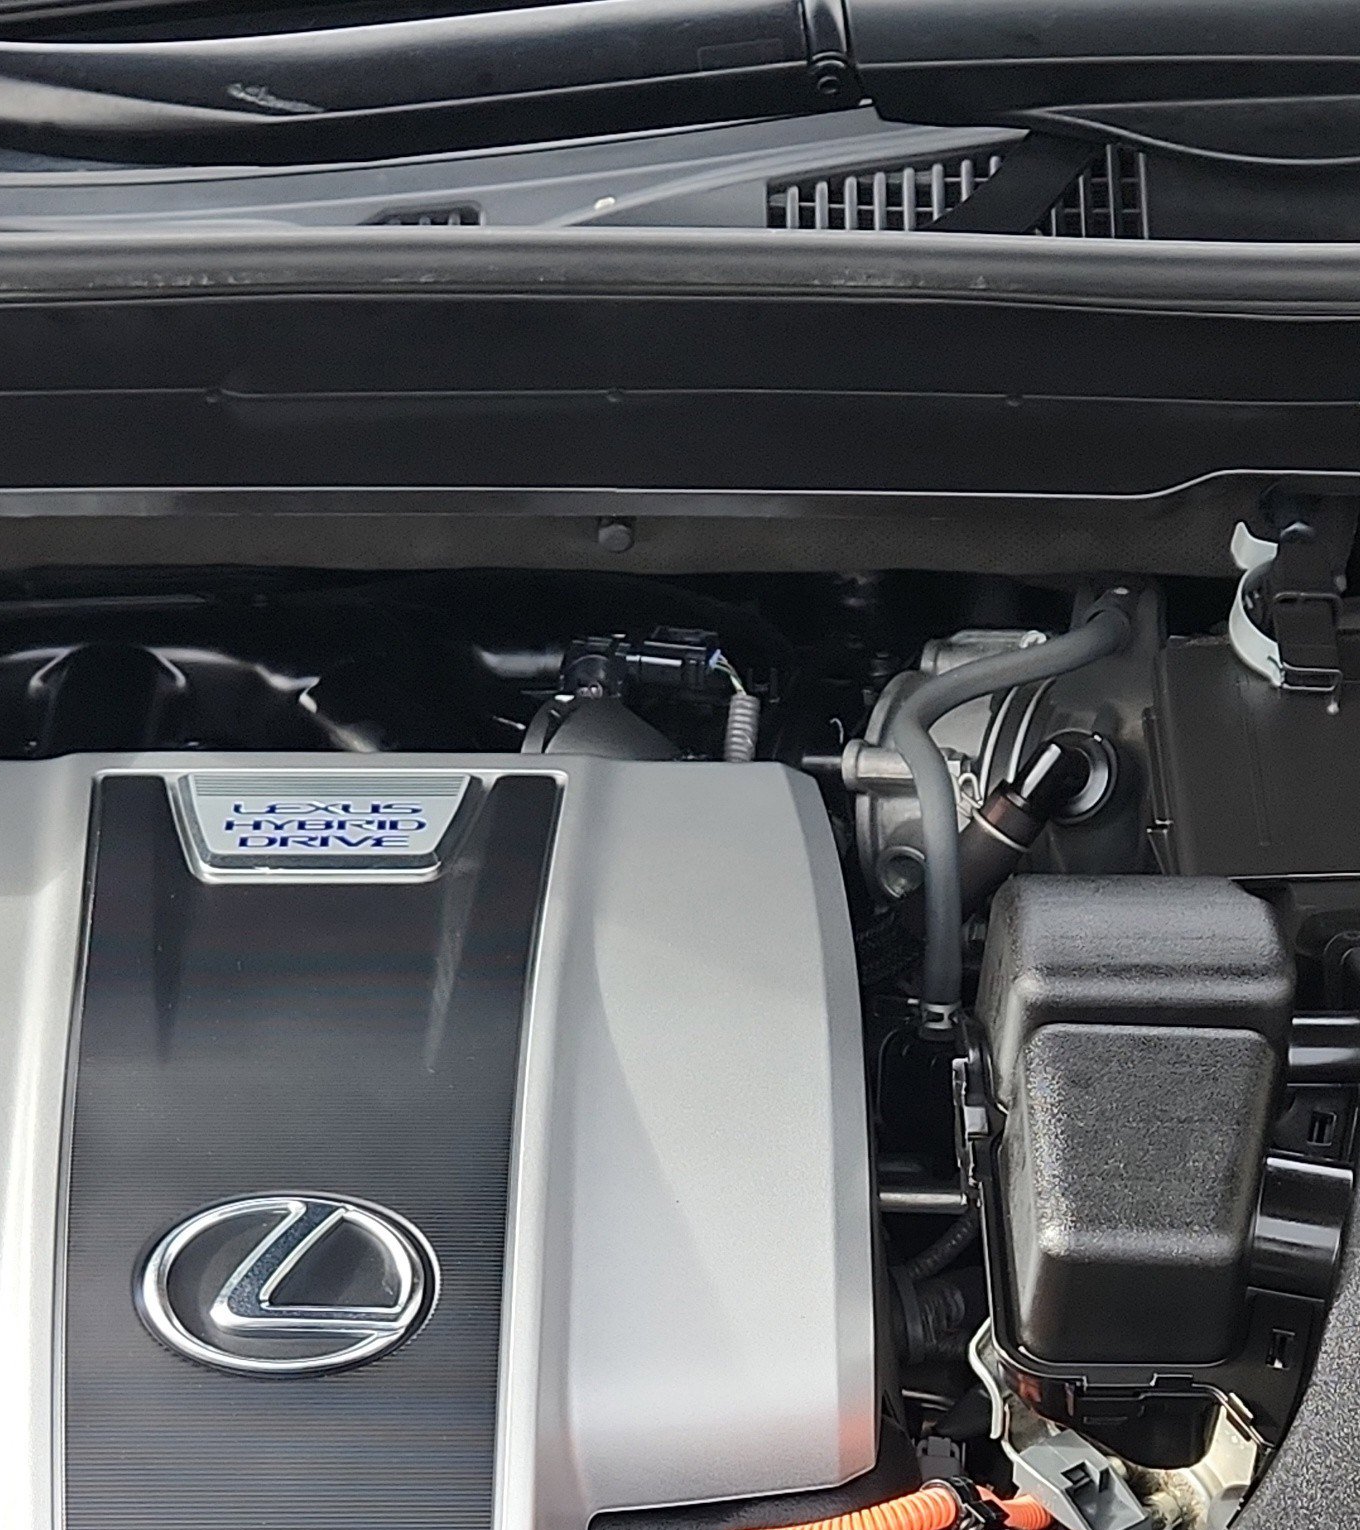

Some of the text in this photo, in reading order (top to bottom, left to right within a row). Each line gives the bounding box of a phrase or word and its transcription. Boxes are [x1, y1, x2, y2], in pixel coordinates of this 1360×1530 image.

[232, 801, 424, 815] LEXUS
[224, 818, 427, 831] HYBRID
[237, 834, 411, 848] DRIVE
